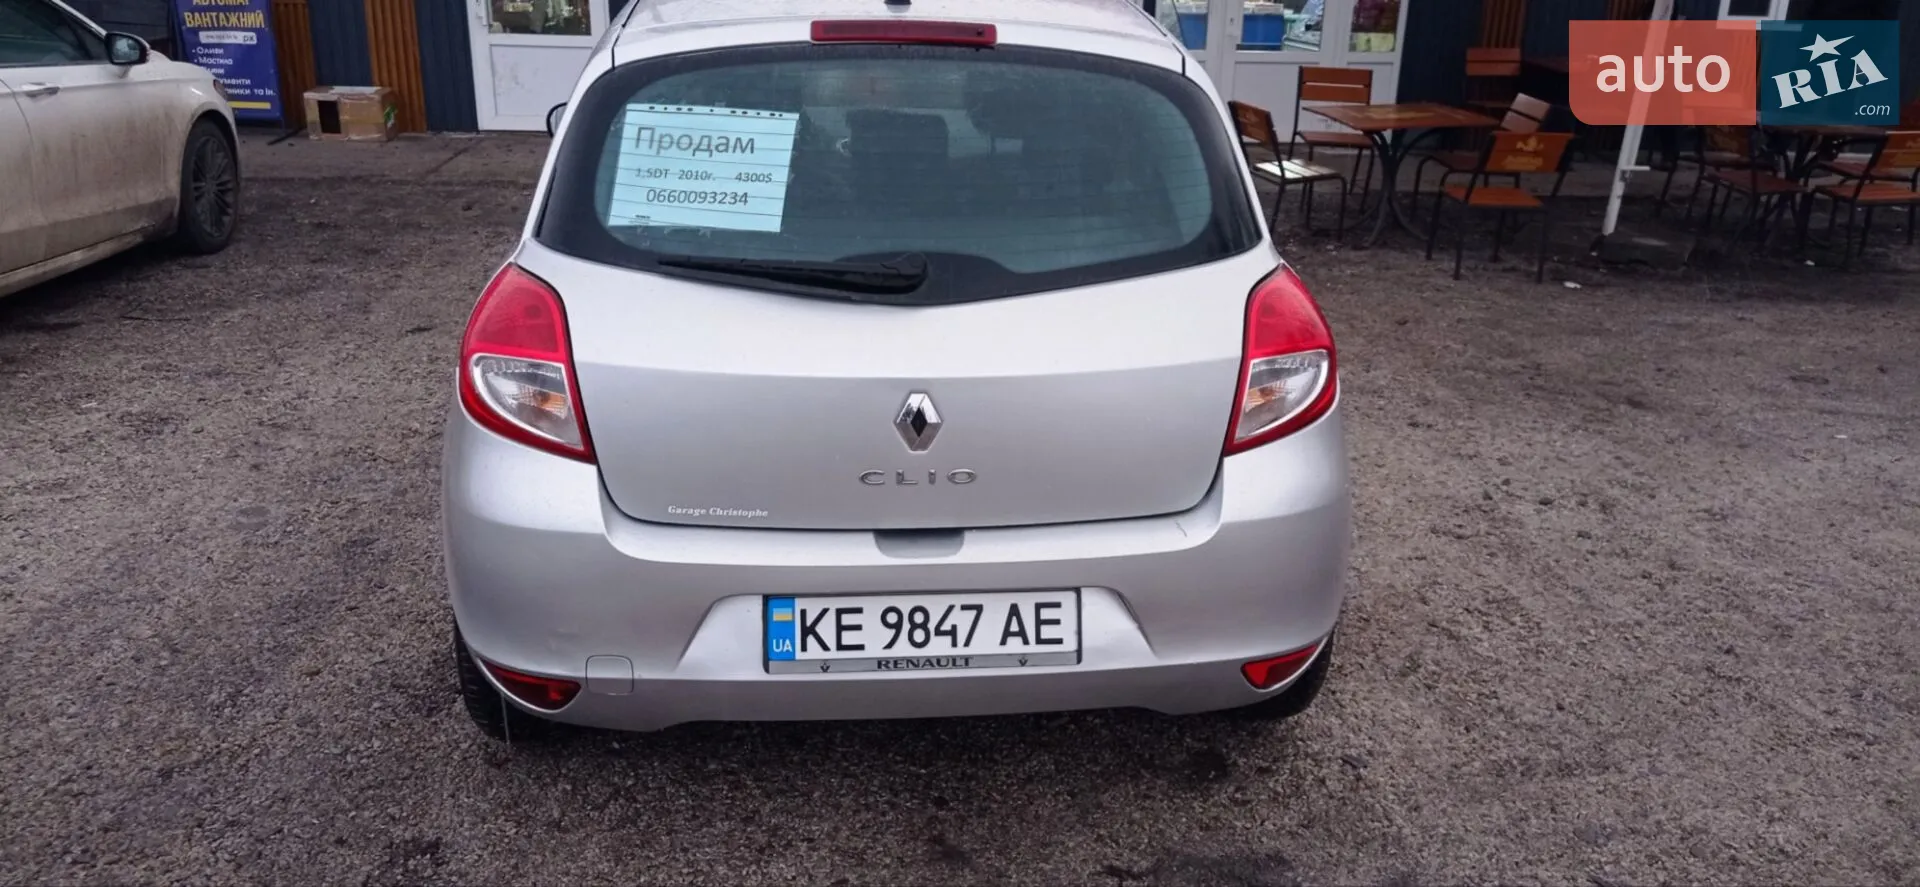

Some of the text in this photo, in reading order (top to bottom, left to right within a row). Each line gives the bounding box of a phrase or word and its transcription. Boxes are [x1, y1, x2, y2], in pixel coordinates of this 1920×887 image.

[184, 9, 265, 28] ВАНТАЖНИЙ
[634, 126, 755, 157] Продам
[734, 171, 773, 184] 4300$
[646, 189, 749, 206] 0660093234
[858, 468, 977, 486] CLIO
[667, 505, 769, 519] Garage Christophe
[772, 601, 1064, 653] UA KE 9847 AE
[876, 656, 974, 670] RENAULT
